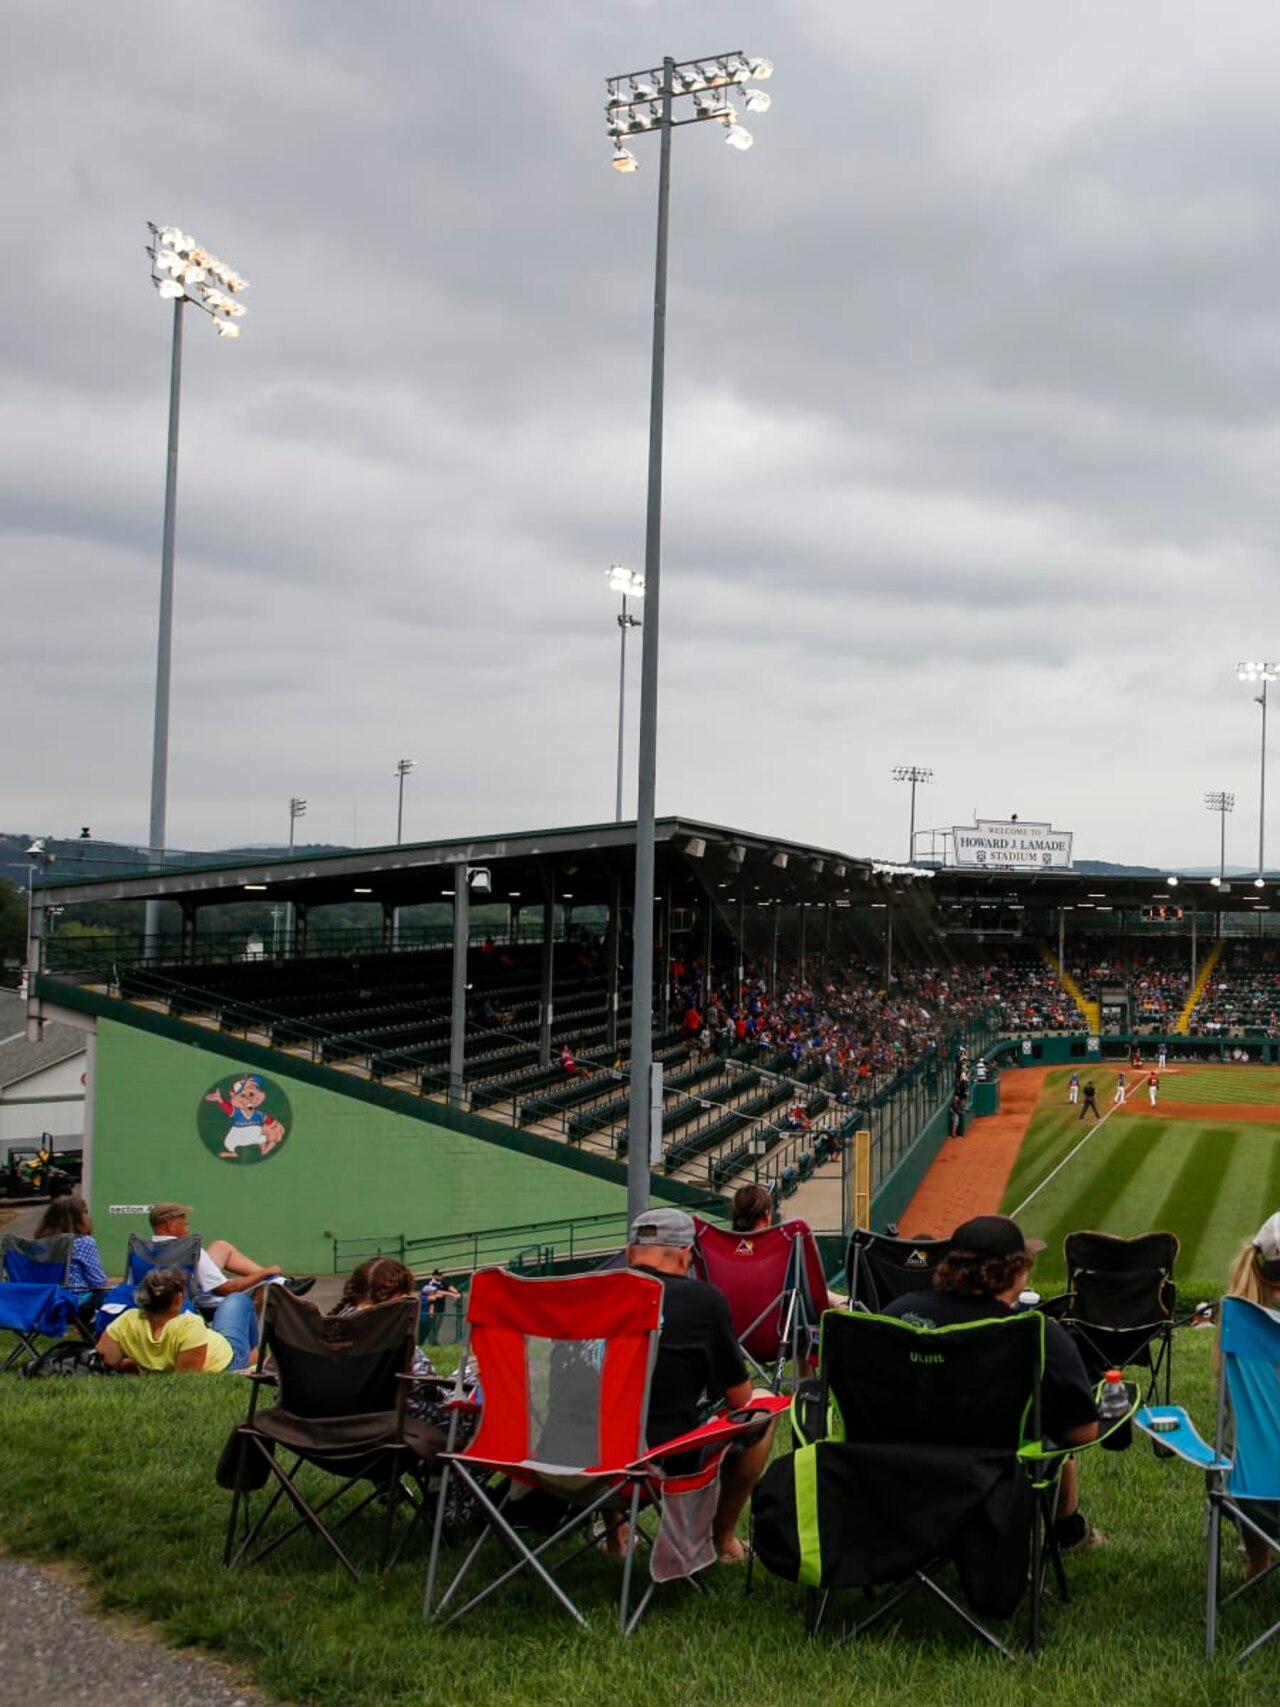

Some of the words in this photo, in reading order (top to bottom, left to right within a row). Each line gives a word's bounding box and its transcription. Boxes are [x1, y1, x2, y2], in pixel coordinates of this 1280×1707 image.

[988, 827, 1027, 836] WELCOME
[1031, 829, 1042, 837] TO
[960, 837, 1009, 849] HOWARD
[1020, 840, 1067, 851] LAMADE
[990, 852, 1037, 861] STADIUM
[910, 1351, 945, 1364] ULINE
